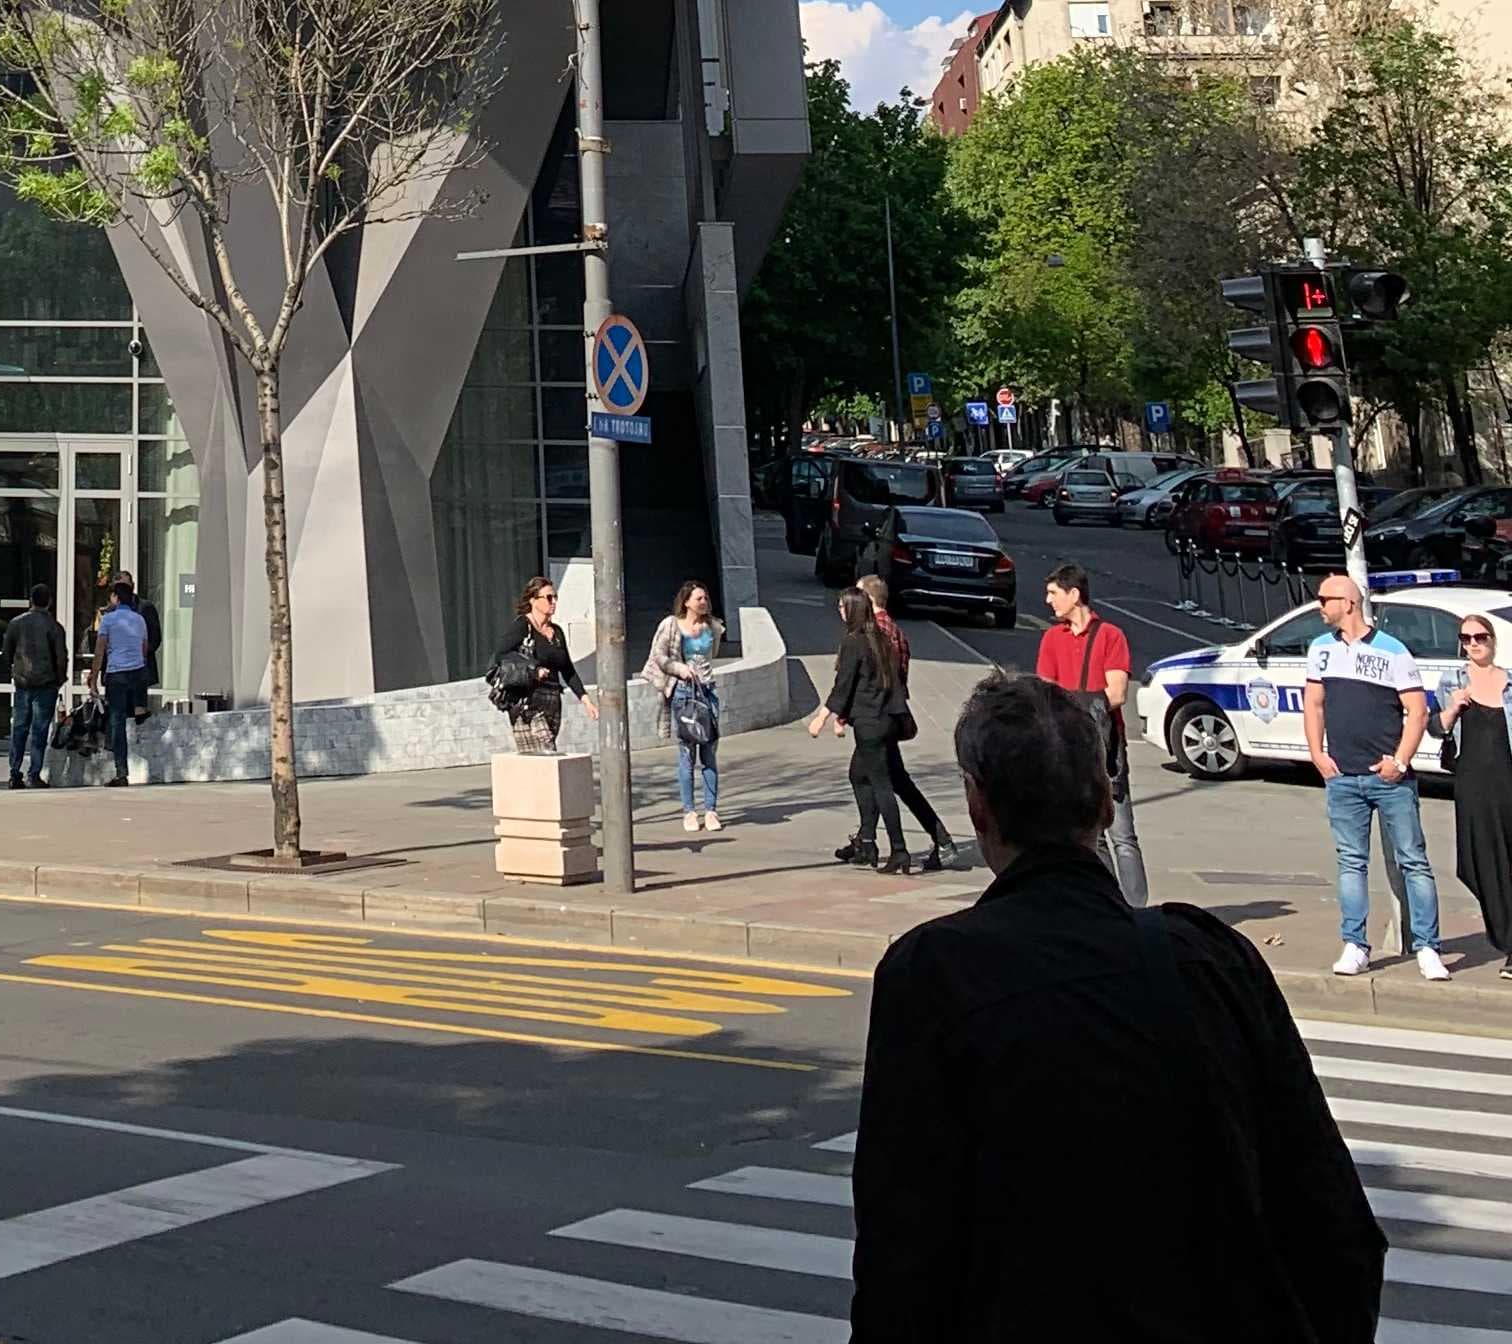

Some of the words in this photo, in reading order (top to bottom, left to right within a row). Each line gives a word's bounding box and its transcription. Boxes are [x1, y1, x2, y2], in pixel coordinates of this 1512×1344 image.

[913, 377, 924, 392] P
[1151, 405, 1164, 422] P
[1319, 651, 1330, 672] 3
[1356, 652, 1389, 671] NORTH
[1355, 663, 1384, 680] WEST
